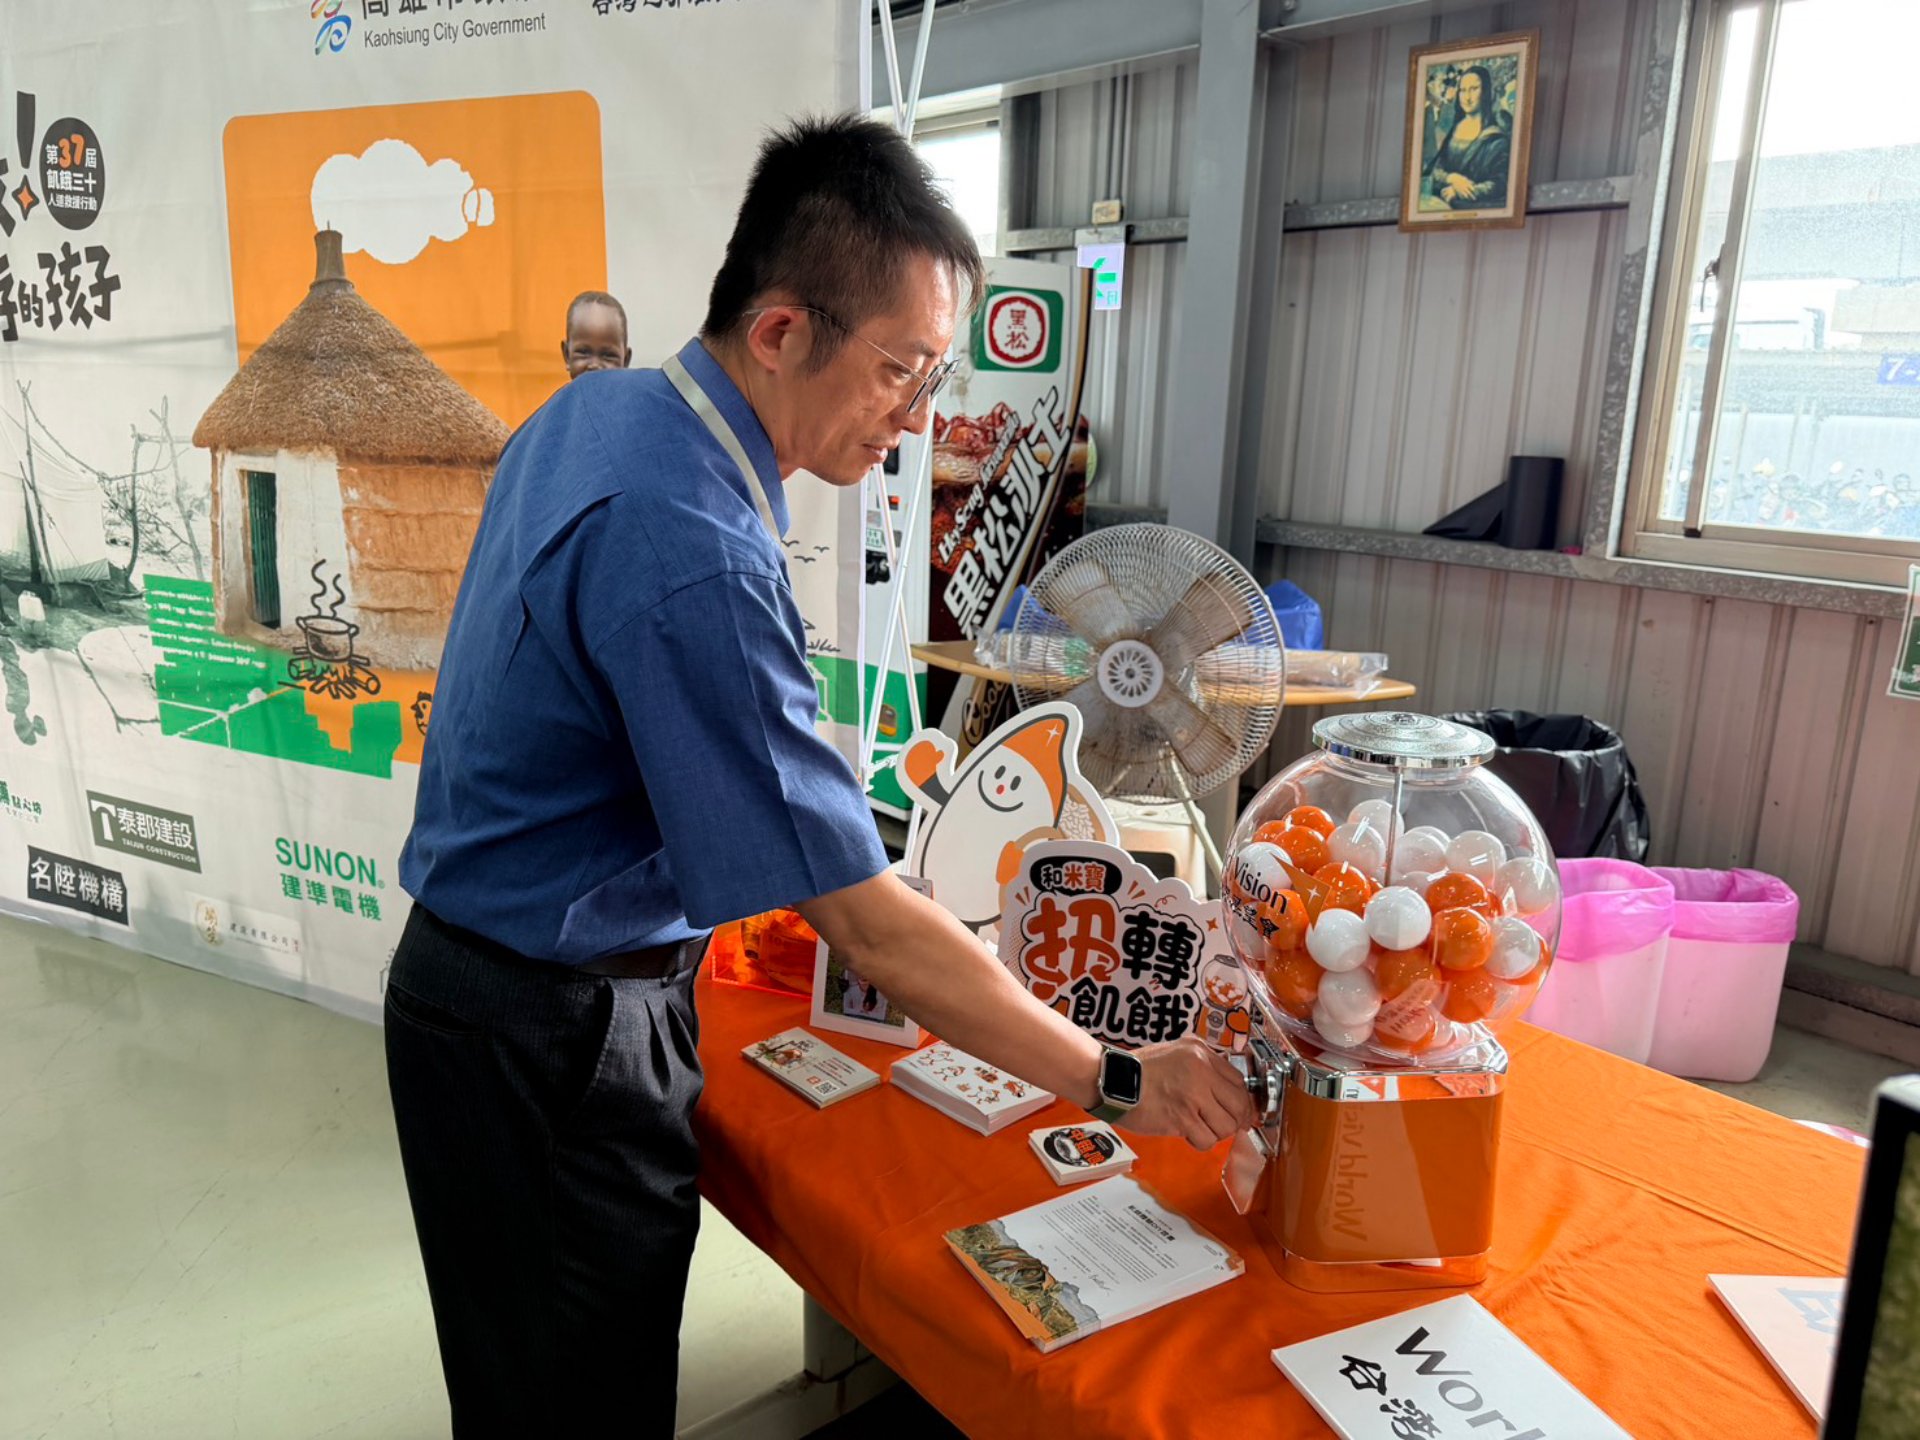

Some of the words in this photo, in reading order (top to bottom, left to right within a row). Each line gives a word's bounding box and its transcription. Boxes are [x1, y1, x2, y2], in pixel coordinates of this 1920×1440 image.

[364, 28, 430, 48] Kaohsiung
[433, 22, 458, 43] City
[462, 13, 547, 38] Government
[45, 133, 97, 169] 第37屆
[46, 168, 97, 194] 飢餓三十
[1004, 308, 1030, 350] 黑松
[943, 385, 1071, 642] 黑松沙士
[116, 807, 195, 850] 泰郡建設
[145, 844, 197, 864] CONSTRUCTION
[31, 856, 124, 913] 名陞機構
[280, 873, 382, 921] 建準電機
[1041, 861, 1107, 891] 和米寶
[1233, 856, 1288, 915] Vision
[1071, 976, 1196, 1043] 飢餓
